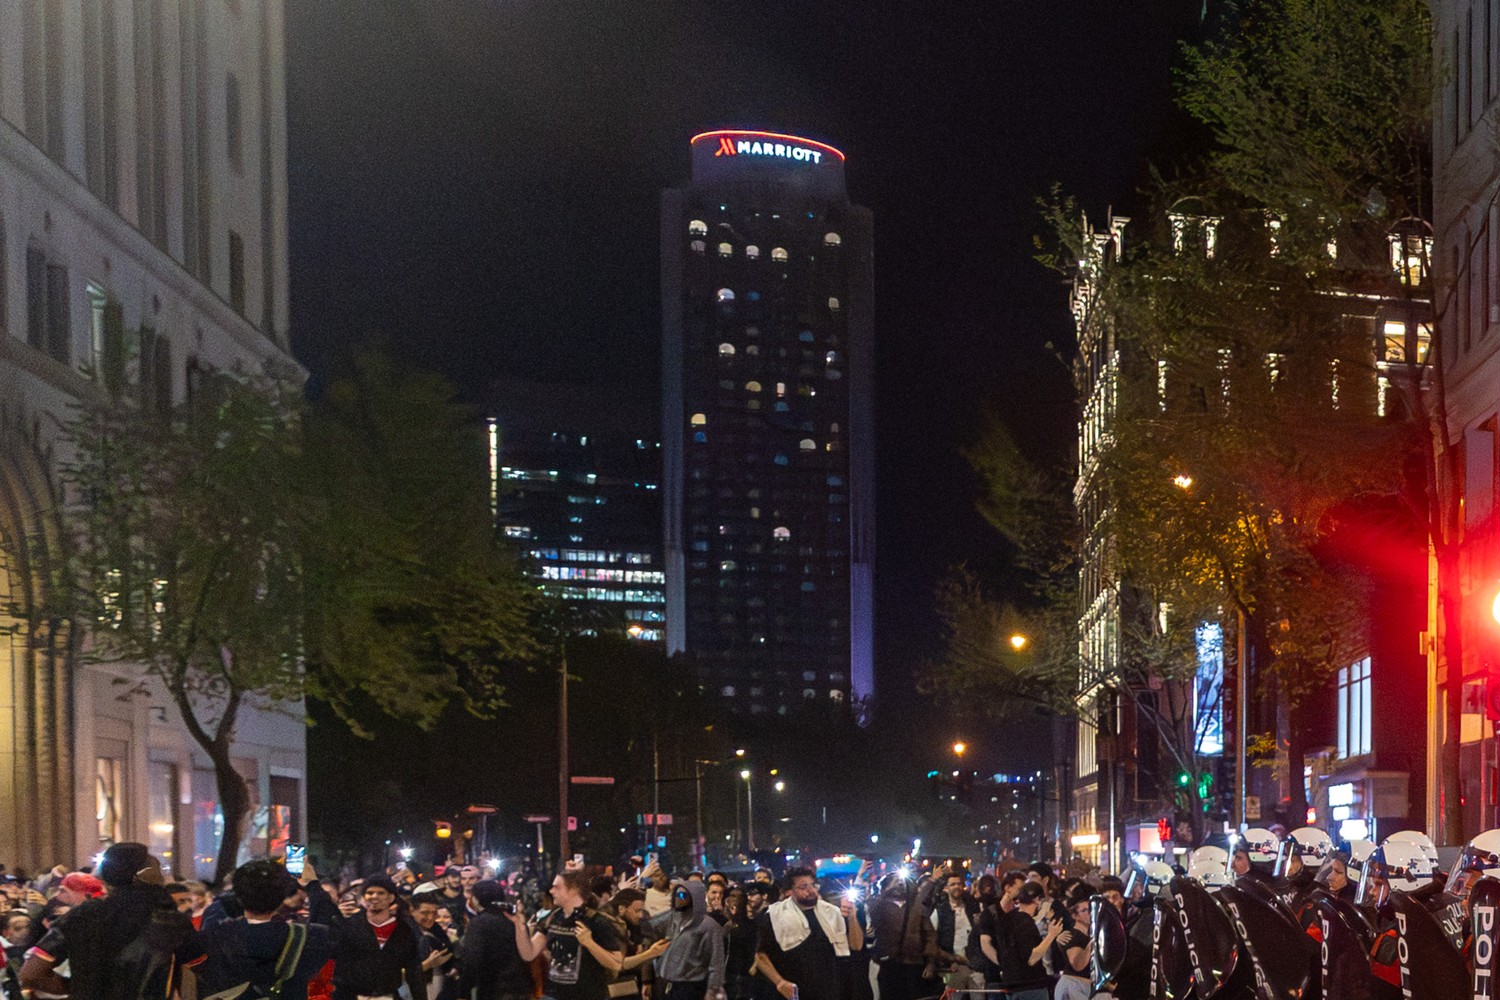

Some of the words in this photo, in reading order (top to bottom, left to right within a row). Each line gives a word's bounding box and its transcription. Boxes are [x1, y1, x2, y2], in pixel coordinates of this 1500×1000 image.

[737, 140, 822, 164] MARRIOTT
[1150, 908, 1162, 997] POLICE
[1174, 893, 1204, 983] POLICE
[1228, 902, 1274, 998] POLICE
